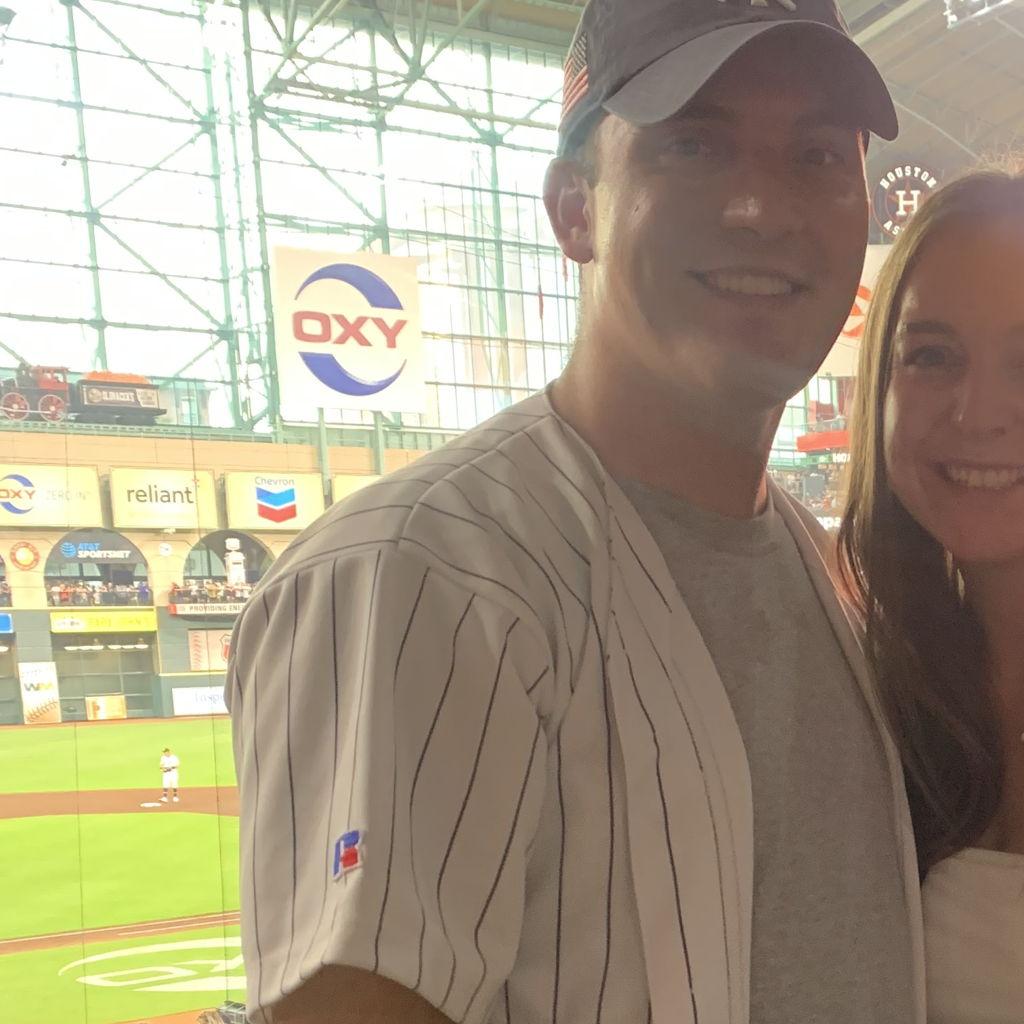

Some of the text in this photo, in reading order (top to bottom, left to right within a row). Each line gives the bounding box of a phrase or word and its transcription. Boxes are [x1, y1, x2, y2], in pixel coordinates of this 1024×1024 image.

[880, 166, 937, 189] HOUSTON
[895, 189, 920, 216] H
[292, 310, 408, 348] OXY
[254, 475, 295, 487] Chevron
[127, 485, 194, 503] reliant
